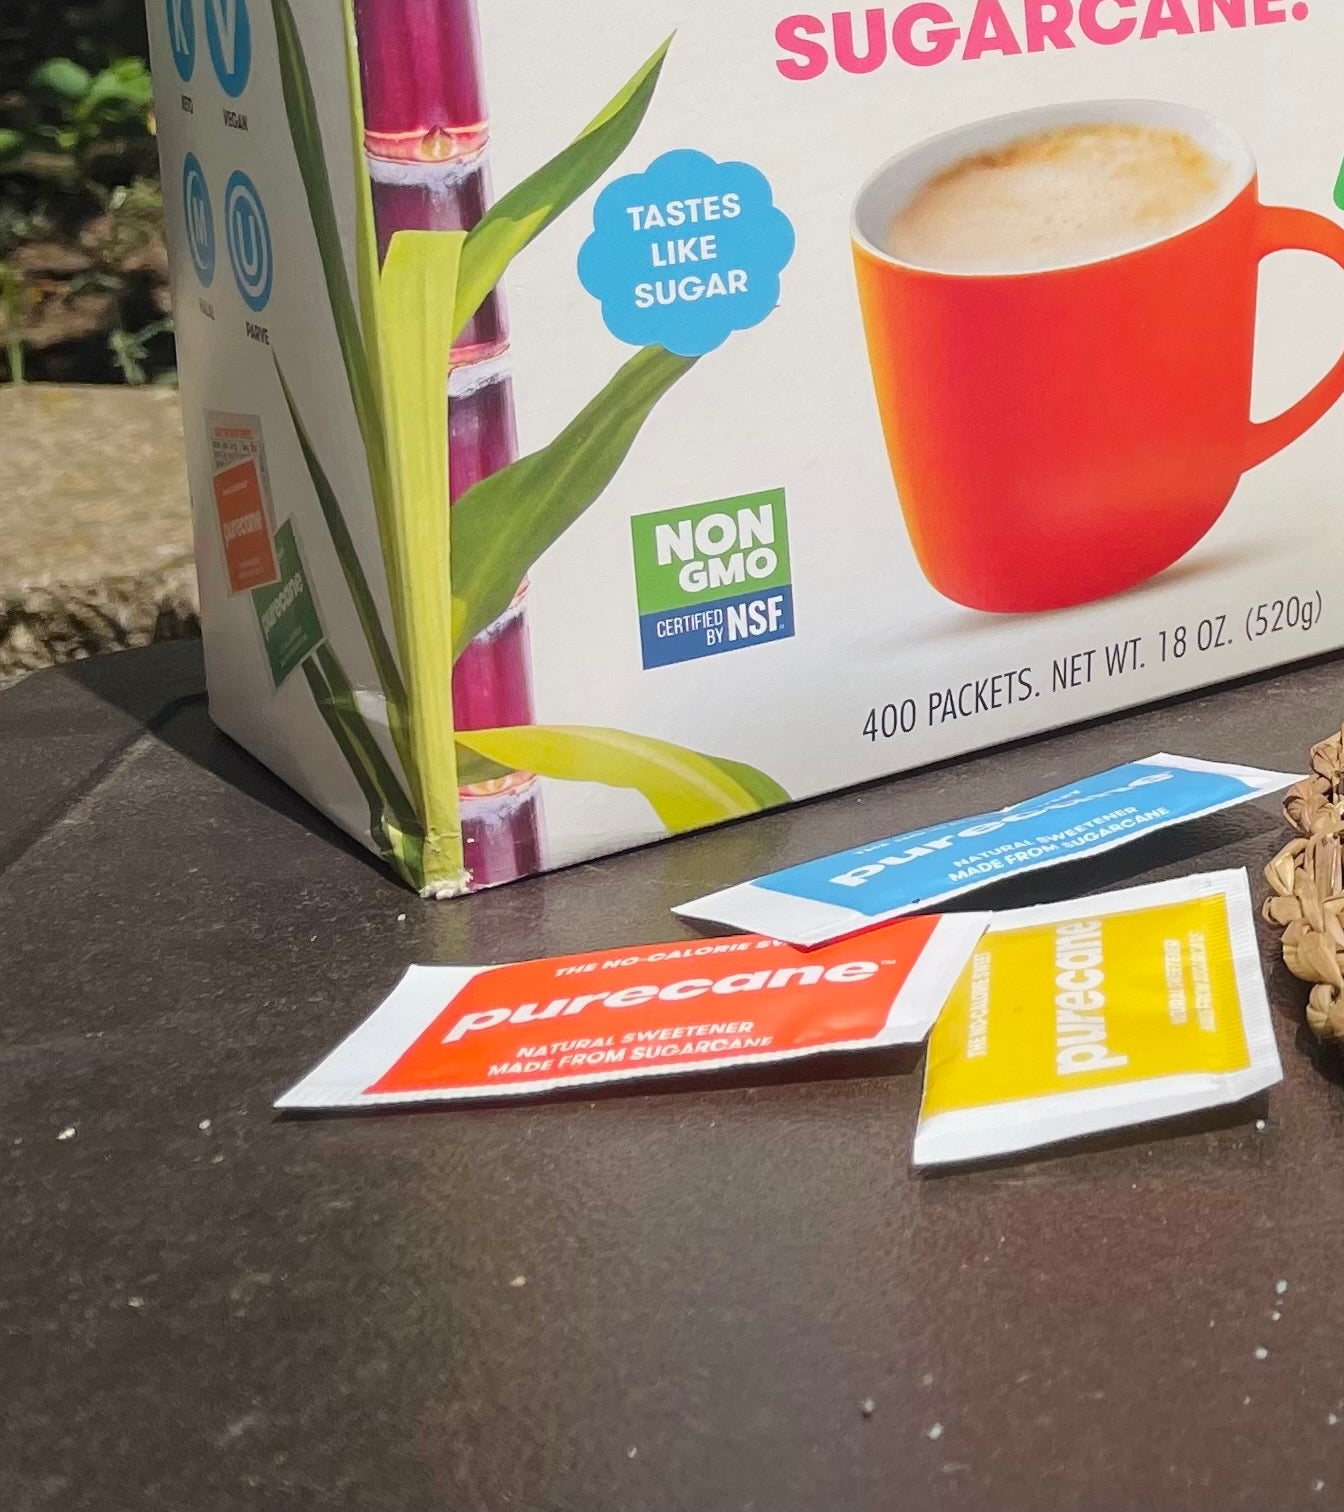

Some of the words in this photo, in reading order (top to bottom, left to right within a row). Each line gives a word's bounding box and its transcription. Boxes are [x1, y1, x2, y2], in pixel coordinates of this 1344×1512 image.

[626, 193, 742, 232] TASTES
[651, 235, 717, 268] LIKE
[635, 269, 748, 309] SUGAR
[655, 503, 775, 566] NON
[678, 547, 778, 592] GMO
[656, 609, 723, 638] CERTIFIED
[706, 627, 723, 646] BY
[726, 595, 784, 642] NSF
[862, 698, 916, 742] 400
[929, 667, 1040, 726] PACKETS.
[1052, 650, 1097, 691] NET
[1105, 637, 1145, 676] WT.
[1158, 626, 1186, 662] 18
[1197, 615, 1234, 652] OZ.
[1245, 589, 1323, 642] (520g)
[948, 860, 1004, 882] MADE
[1004, 843, 1058, 866] FROM
[1060, 806, 1170, 850] SUGARCANE
[953, 839, 1033, 867] NATURAL
[1035, 805, 1138, 845] SWEETENER
[555, 962, 598, 978] THE
[602, 942, 749, 970] NO-CALORIE
[1055, 917, 1129, 1077] purecane
[488, 1058, 552, 1077] MADE
[558, 1049, 624, 1068] FROM
[630, 1036, 774, 1063] SUGARCANE
[516, 1036, 616, 1060] NATURAL
[621, 1021, 754, 1045] SWEETENER
